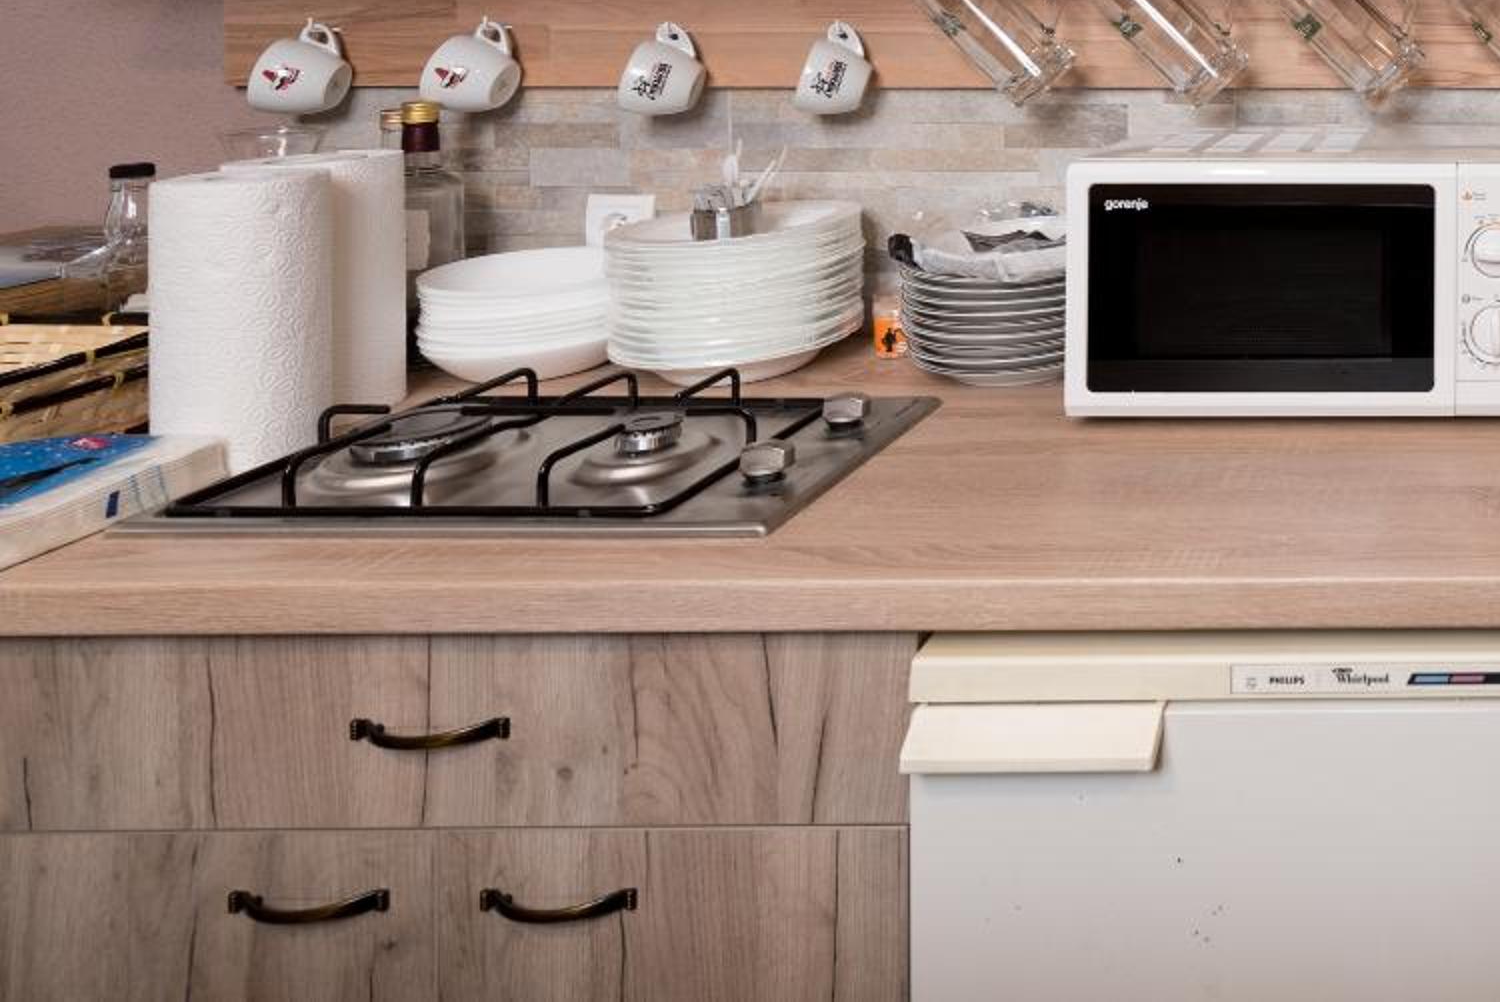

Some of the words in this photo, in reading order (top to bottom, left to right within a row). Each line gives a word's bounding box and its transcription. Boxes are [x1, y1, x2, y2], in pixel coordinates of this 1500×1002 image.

[1104, 198, 1150, 211] gorenje
[1268, 675, 1305, 686] PHILIPS
[1338, 672, 1390, 688] Whirlpool
